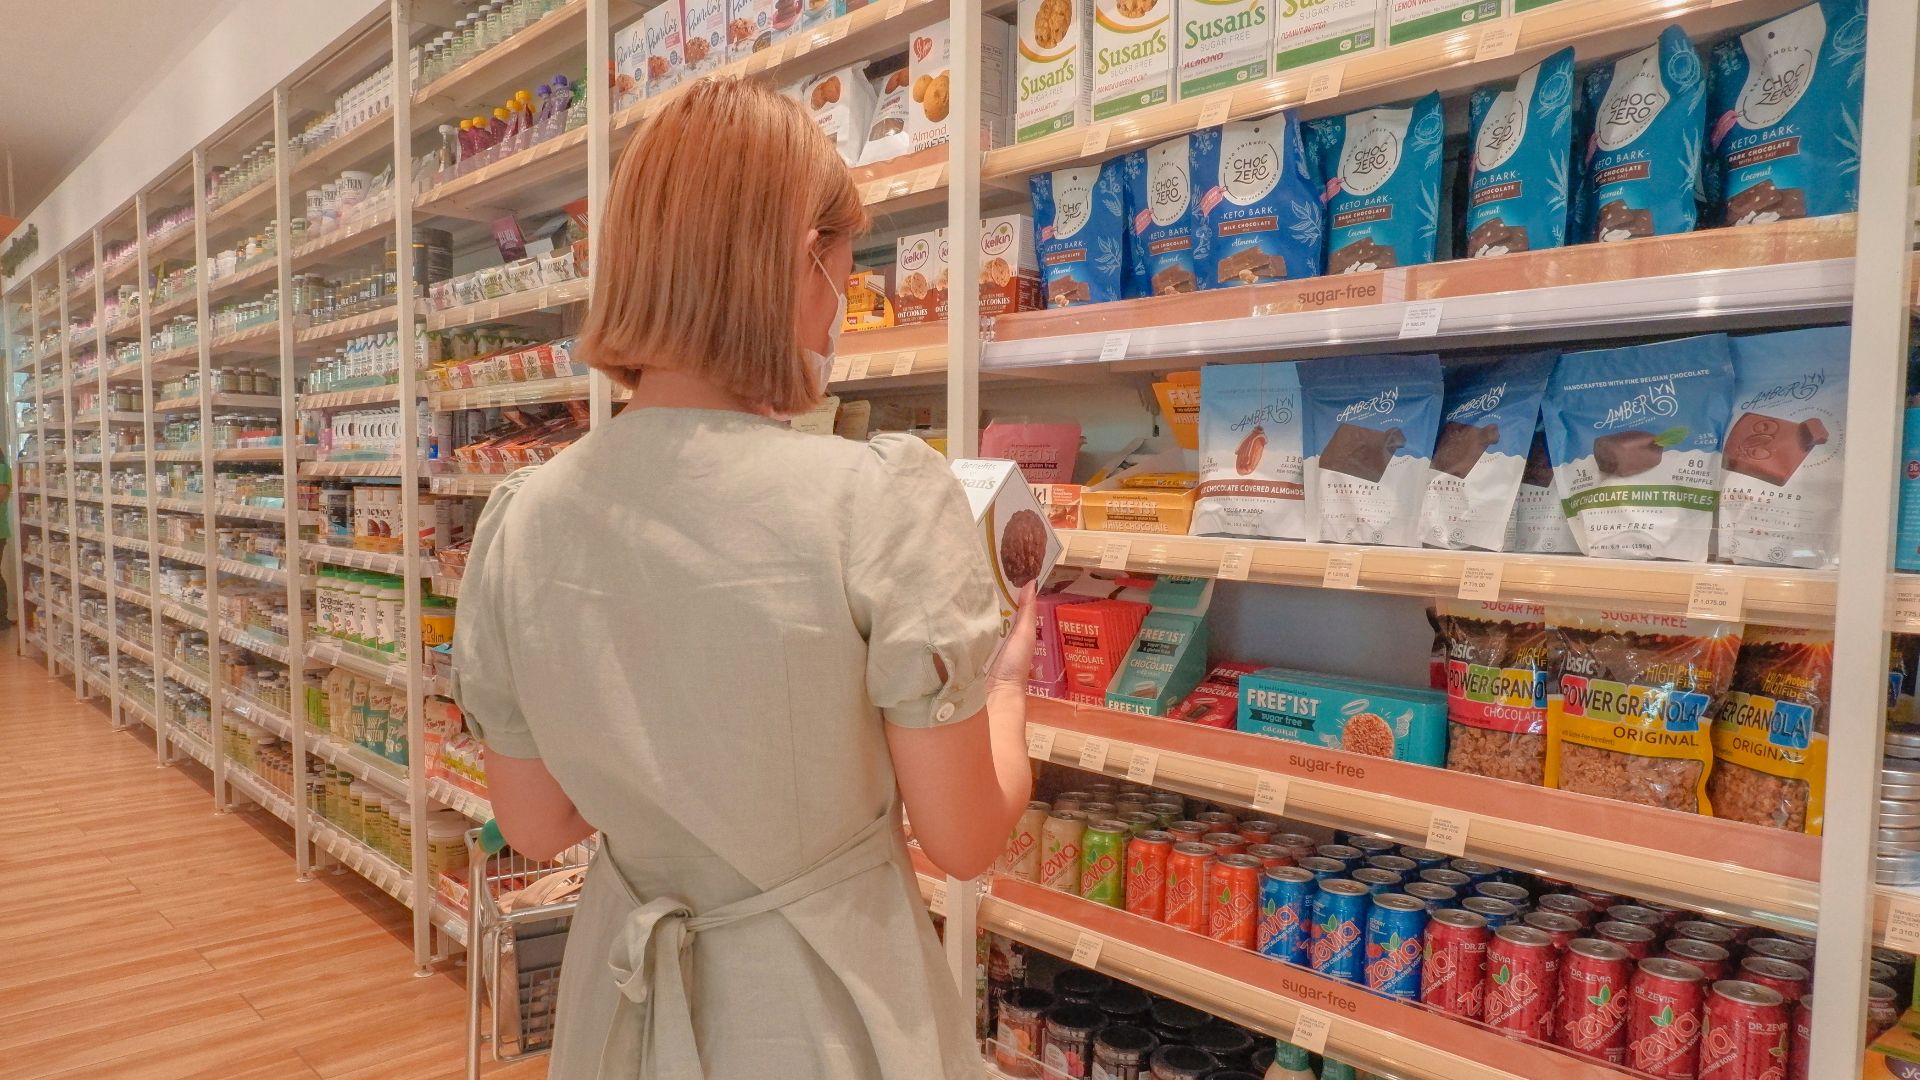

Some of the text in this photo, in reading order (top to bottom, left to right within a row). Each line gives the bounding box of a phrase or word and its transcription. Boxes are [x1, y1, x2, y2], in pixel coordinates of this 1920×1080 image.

[1300, 7, 1330, 21] SUGAR
[1185, 5, 1266, 49] Susan's
[1200, 31, 1251, 51] SUGAR FREE
[1098, 30, 1167, 75] Susan's
[1134, 60, 1153, 71] FREE
[1021, 60, 1074, 101] Susan's
[1763, 64, 1805, 92] CHOC
[1756, 78, 1799, 106] ZERO
[1609, 93, 1657, 111] CHOC
[1607, 107, 1651, 125] ZERO
[912, 125, 947, 143] Almond
[1731, 125, 1794, 150] KETO BARK
[1354, 142, 1389, 163] CHOC
[1617, 149, 1644, 162] BARK
[1729, 141, 1791, 163] DARK CHOCOLATE
[1233, 153, 1269, 170] CHOC
[1353, 153, 1389, 175] ZERO
[1233, 165, 1270, 184] ZERO
[1490, 171, 1516, 182] BARK
[1604, 165, 1642, 178] CHOCOLATE
[1741, 165, 1773, 182] Coconut
[1155, 177, 1179, 193] CHOC
[1482, 184, 1515, 196] CHOCOLATE
[1156, 188, 1181, 205] ZERO
[1339, 196, 1389, 212] KETO BARK
[1223, 206, 1274, 221] KETO BARK
[1338, 208, 1387, 222] DARK CHOCOLATE
[1169, 228, 1190, 237] BARK
[1238, 220, 1272, 230] CHOCOLATE
[985, 234, 1011, 250] kelkin
[1065, 241, 1083, 249] BARK
[1231, 237, 1264, 248] Almond
[903, 249, 927, 265] kelkin
[987, 297, 1010, 306] COOKIES
[1297, 284, 1376, 305] sugar-free
[907, 309, 928, 318] COOKIES
[1564, 369, 1709, 391] HANDCRAFTED WITH FINE BELGIAN CHOCOLATE
[1741, 368, 1825, 410] AMBERLYN
[1336, 386, 1399, 422] AMBERLYN
[1446, 382, 1506, 421] AMBERLYN
[1594, 380, 1678, 430] AMBERLYN
[1231, 394, 1294, 432] AMBERLYN
[1678, 468, 1710, 477] CALORIES
[1688, 460, 1703, 469] 80
[1910, 463, 1918, 471] 36
[1240, 484, 1270, 493] COVERED
[1271, 485, 1304, 496] ALMONDS
[1685, 477, 1713, 486] TRUFFLE
[1631, 490, 1660, 501] MINT
[1662, 491, 1713, 506] TRUFFLES
[1760, 490, 1802, 501] ADDED
[1589, 523, 1655, 532] SUGAR-FREE
[1482, 600, 1524, 614] SUGAR
[1059, 621, 1100, 636] FREE'IST
[1139, 628, 1186, 643] FREE'IST
[1450, 638, 1475, 660] Basic
[1064, 652, 1105, 665] CHOCOLATE
[1130, 659, 1174, 673] CHOCOLATE
[1566, 652, 1596, 675] Basic
[1108, 700, 1151, 716] FREE'IST
[1247, 689, 1320, 717] FREE'IST
[1563, 683, 1699, 724] POWER GRANOLA
[1261, 713, 1303, 726] sugar free
[1484, 706, 1543, 721] CHOCOLATE
[1737, 703, 1809, 738] GRANOLA
[1262, 725, 1299, 738] coconut
[1613, 726, 1699, 747] ORIGINAL
[1733, 738, 1804, 765] ORIGINAL
[1289, 755, 1366, 779] sugar-free
[1312, 920, 1361, 969] zevia
[1330, 948, 1349, 965] CALORIE
[1349, 937, 1362, 950] SODA
[1366, 937, 1422, 989] zevia
[1391, 965, 1413, 985] CALORIE
[1585, 972, 1612, 984] ZEVIA
[1282, 978, 1356, 1010] sugar-free
[1647, 991, 1676, 1004] ZEVIA
[1501, 992, 1538, 1021] CALORIE SODA
[1749, 1022, 1765, 1031] DR.
[1585, 1021, 1623, 1051] ZERO CALORIE
[1630, 1011, 1700, 1069] zevia
[1648, 1044, 1688, 1074] ZERO CALORIE
[1720, 1053, 1738, 1066] SODA
